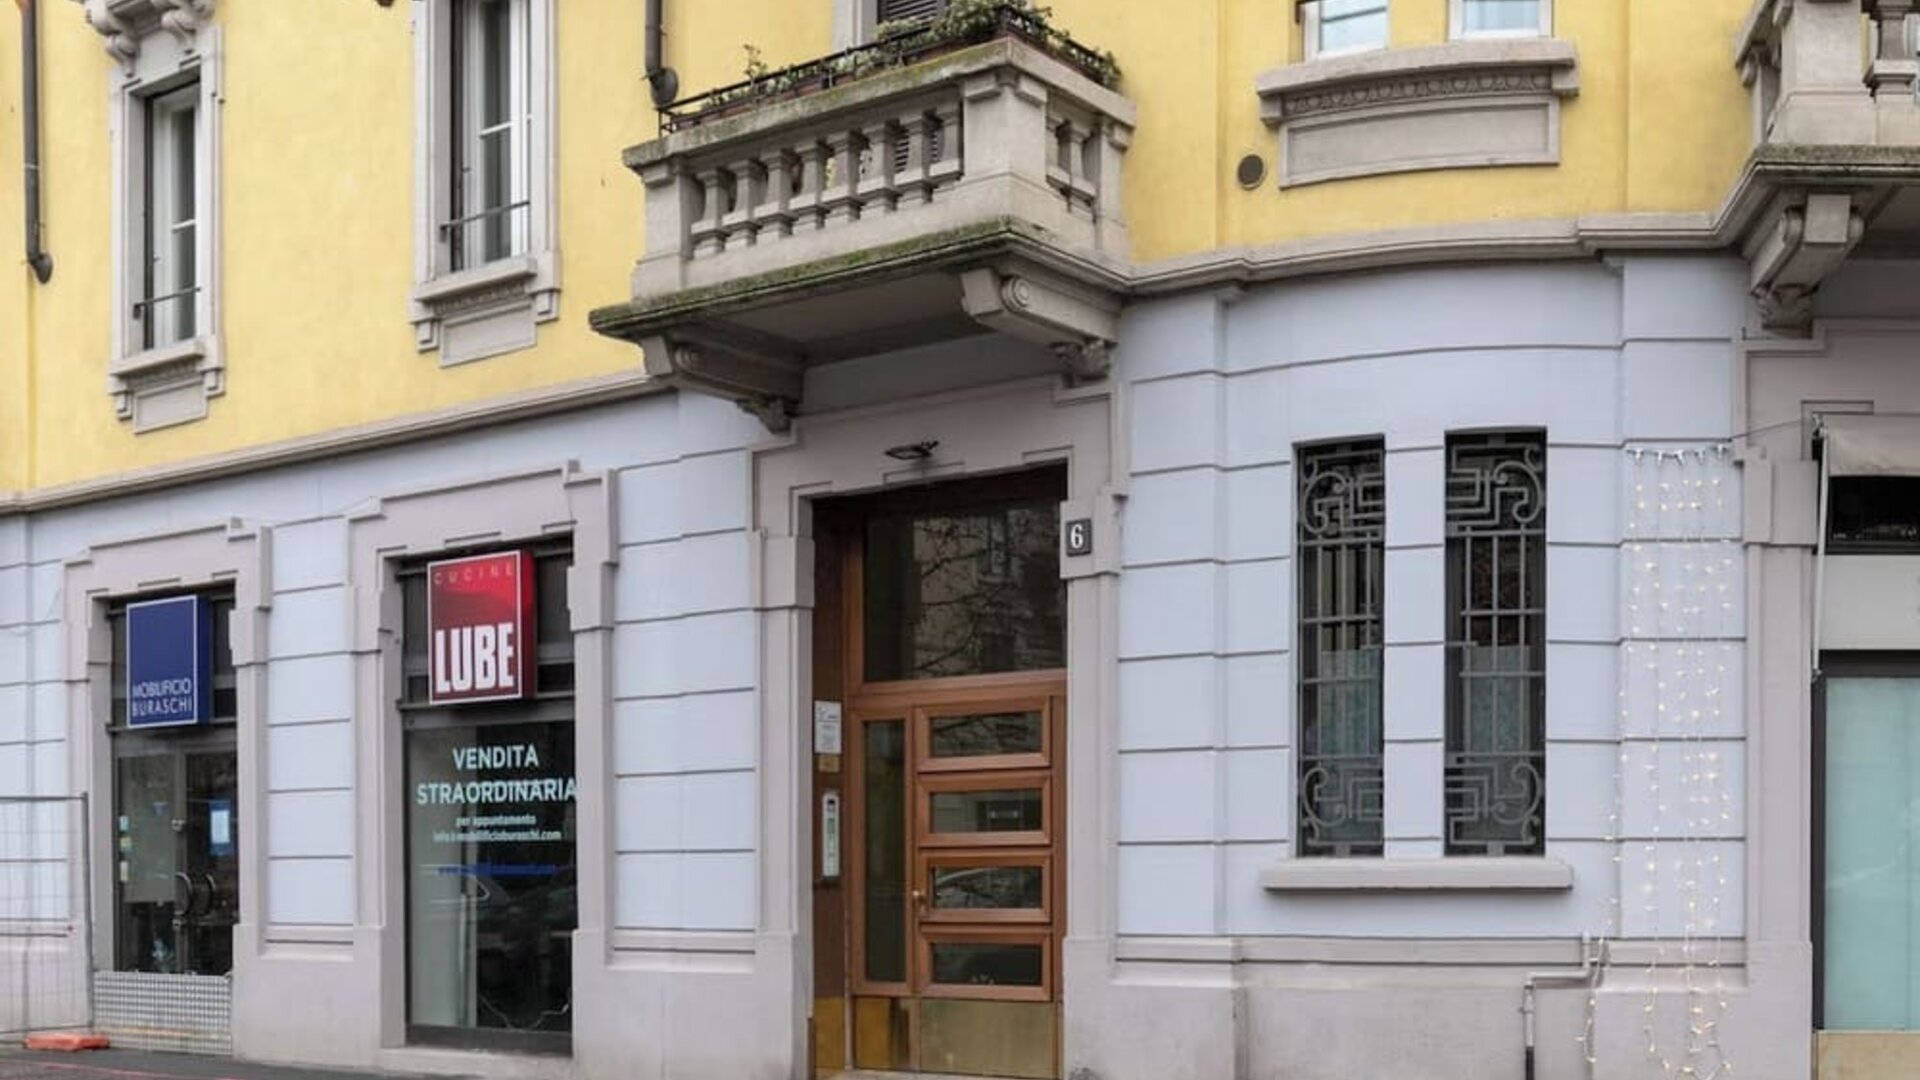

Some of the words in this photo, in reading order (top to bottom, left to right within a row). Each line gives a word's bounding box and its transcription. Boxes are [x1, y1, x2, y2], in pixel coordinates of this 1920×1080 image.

[1070, 523, 1084, 549] 6
[435, 621, 515, 693] LUBE
[132, 677, 193, 698] MOBILIFICIO
[132, 695, 193, 717] BURASCHI
[452, 744, 539, 770] VENDITA
[416, 776, 578, 805] STRAORDINARIA
